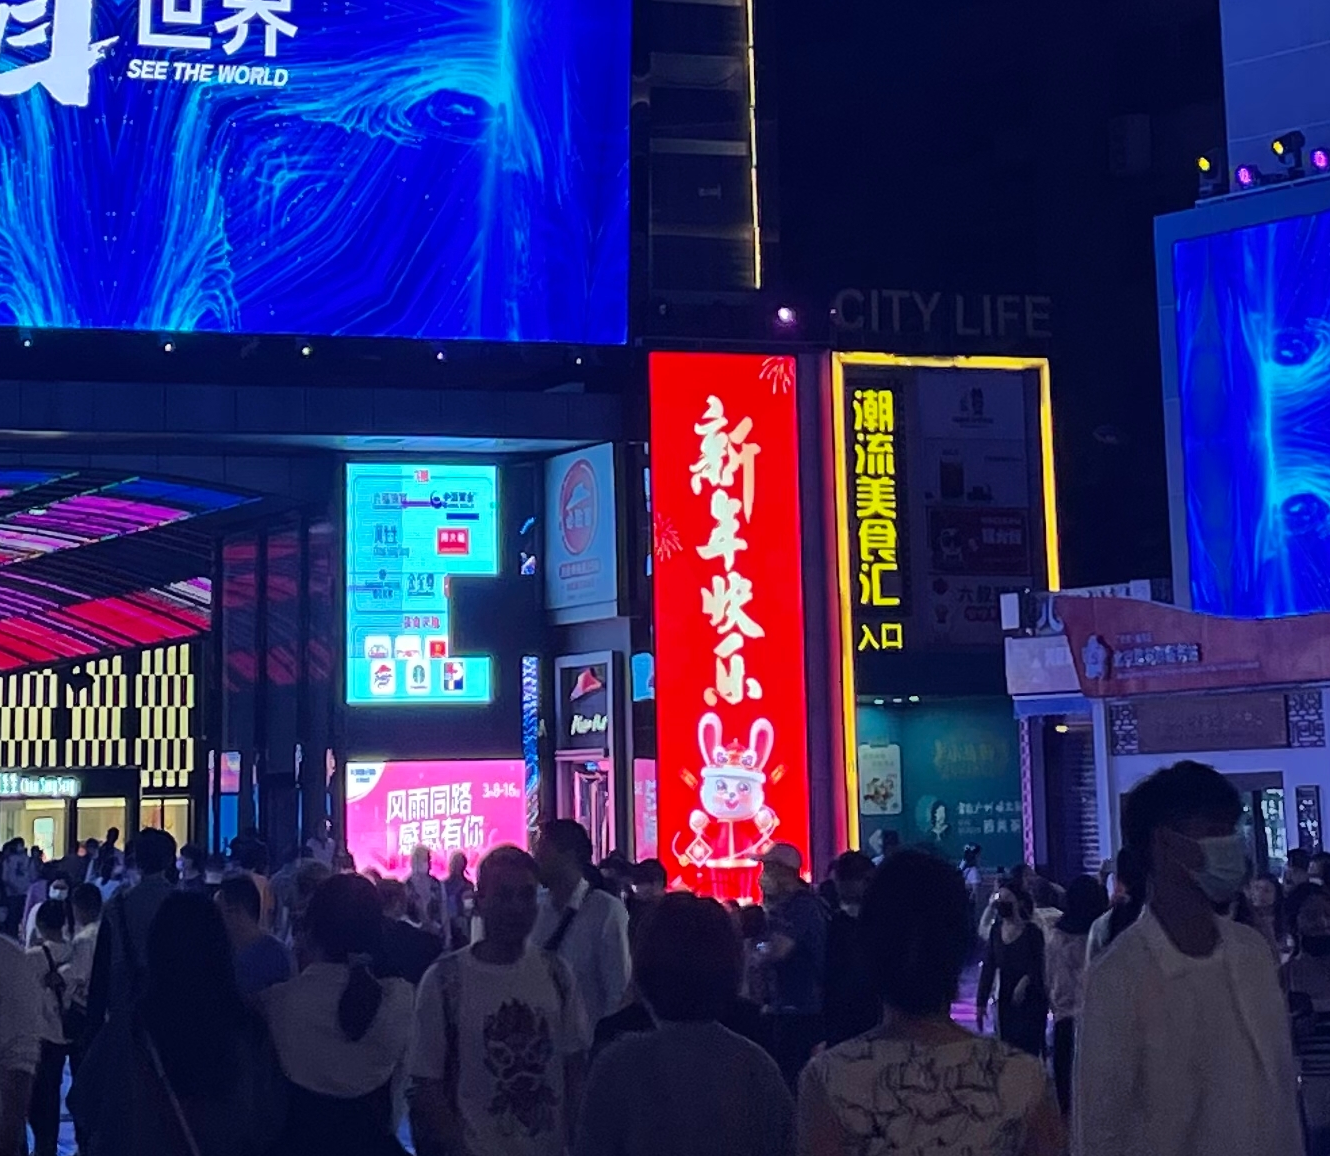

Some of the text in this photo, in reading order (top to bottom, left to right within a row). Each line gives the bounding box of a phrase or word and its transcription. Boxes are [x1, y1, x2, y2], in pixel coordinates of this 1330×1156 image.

[127, 58, 289, 86] SEE THE WORLD
[833, 288, 1052, 338] CITY LIFE
[853, 389, 901, 606] 潮流美食汇
[689, 395, 766, 707] 新年快乐
[858, 622, 904, 651] 入口
[386, 782, 472, 823] 风雨同路
